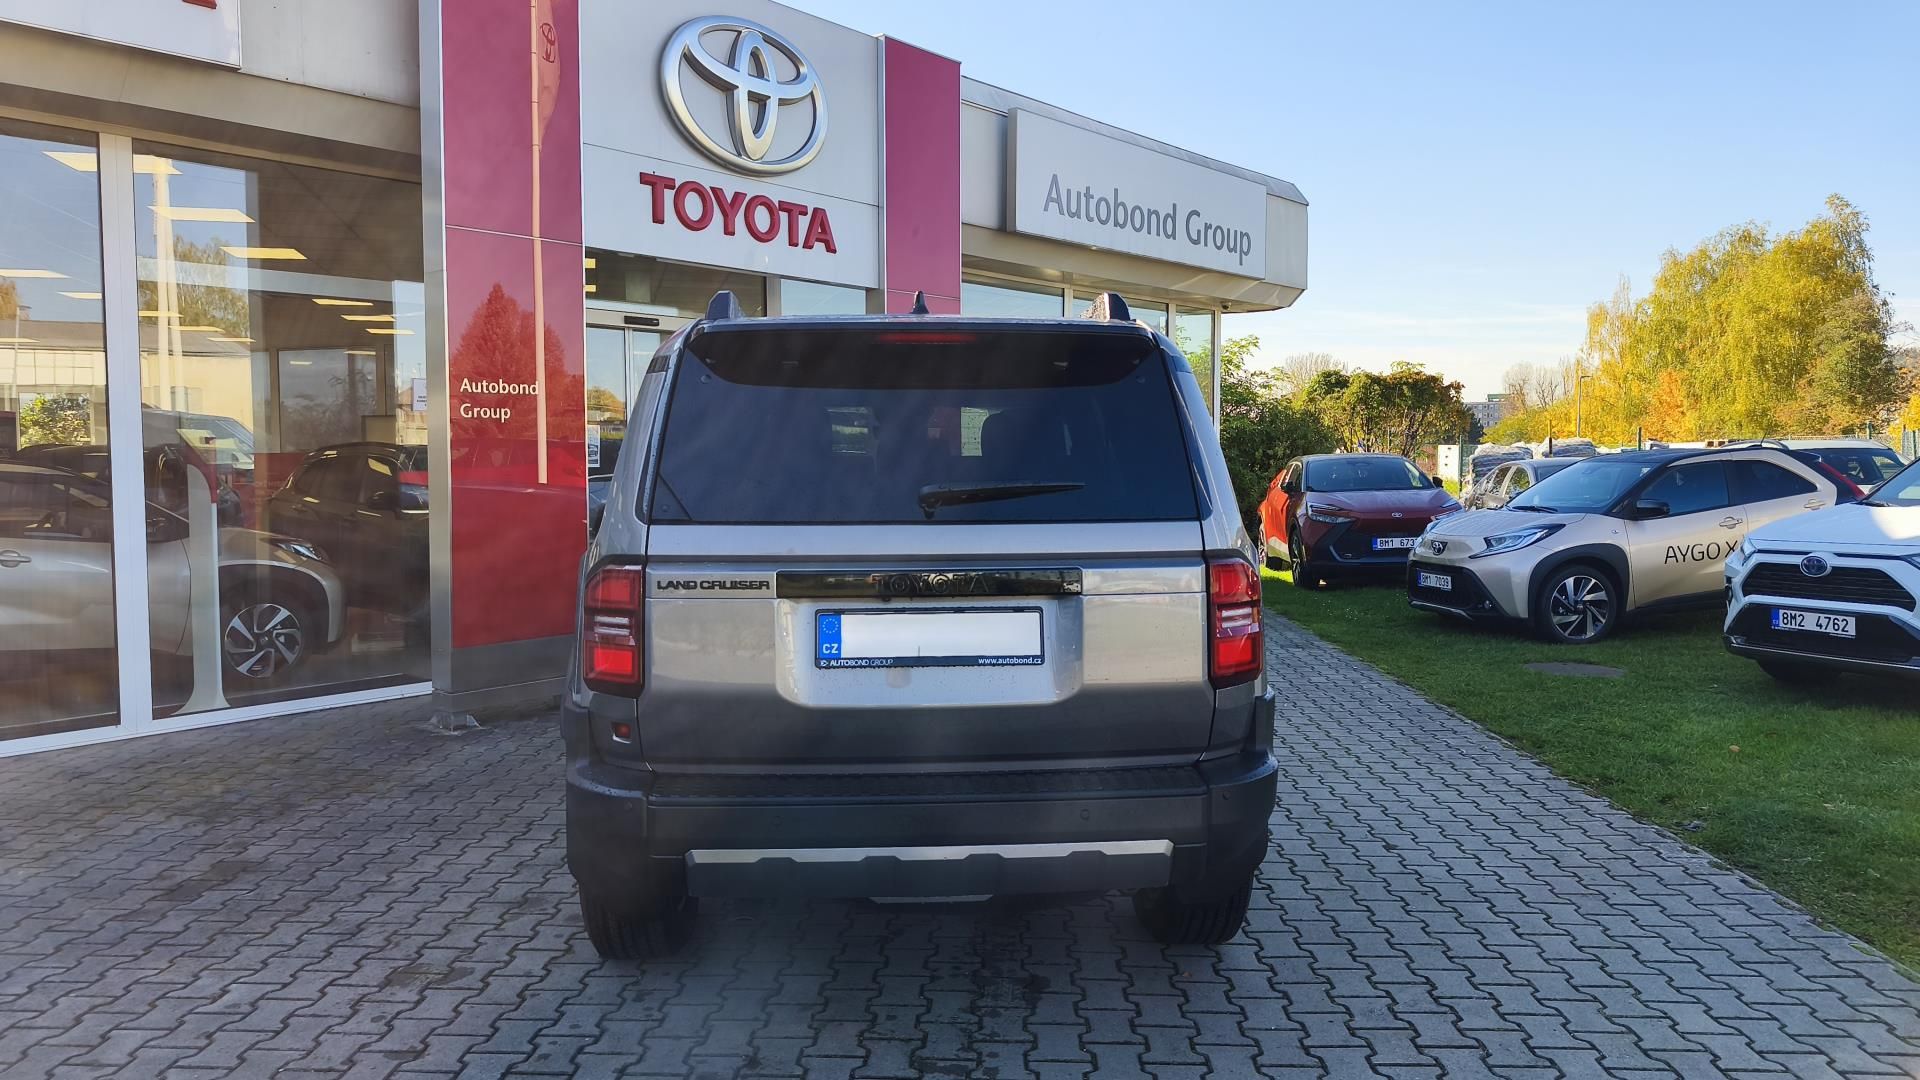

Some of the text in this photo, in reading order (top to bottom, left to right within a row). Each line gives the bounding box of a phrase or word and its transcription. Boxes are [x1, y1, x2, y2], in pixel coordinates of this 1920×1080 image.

[639, 172, 837, 254] TOYOTA
[1043, 173, 1251, 266] Autobond Group
[459, 378, 539, 395] Autobond
[459, 403, 511, 422] Group
[1379, 538, 1417, 547] 8M1 673
[1664, 540, 1738, 564] AYGO X
[657, 580, 770, 590] LAND CRUISER
[871, 573, 989, 594] TOYOTA
[1782, 612, 1849, 633] 8M2 4762
[822, 643, 839, 654] CZ
[829, 659, 869, 667] AUTOBOND
[978, 656, 1042, 665] www.autobond.cz
